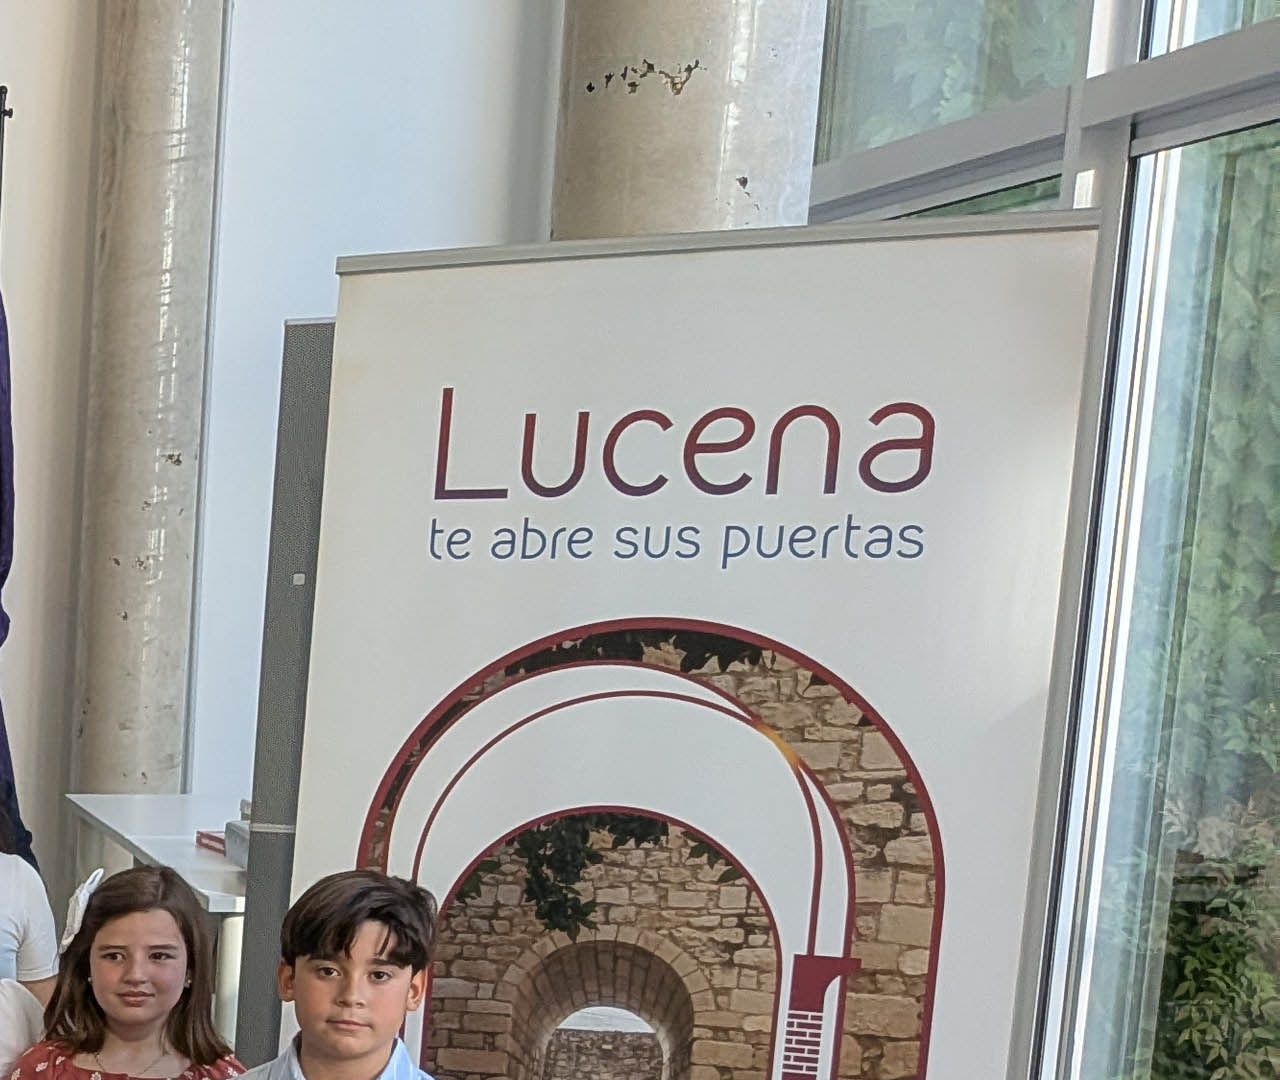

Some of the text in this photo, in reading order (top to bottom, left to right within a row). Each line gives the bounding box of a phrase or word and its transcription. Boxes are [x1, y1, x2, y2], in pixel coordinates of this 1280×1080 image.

[434, 387, 936, 500] Lucena
[429, 514, 926, 569] te abre sus puertas
